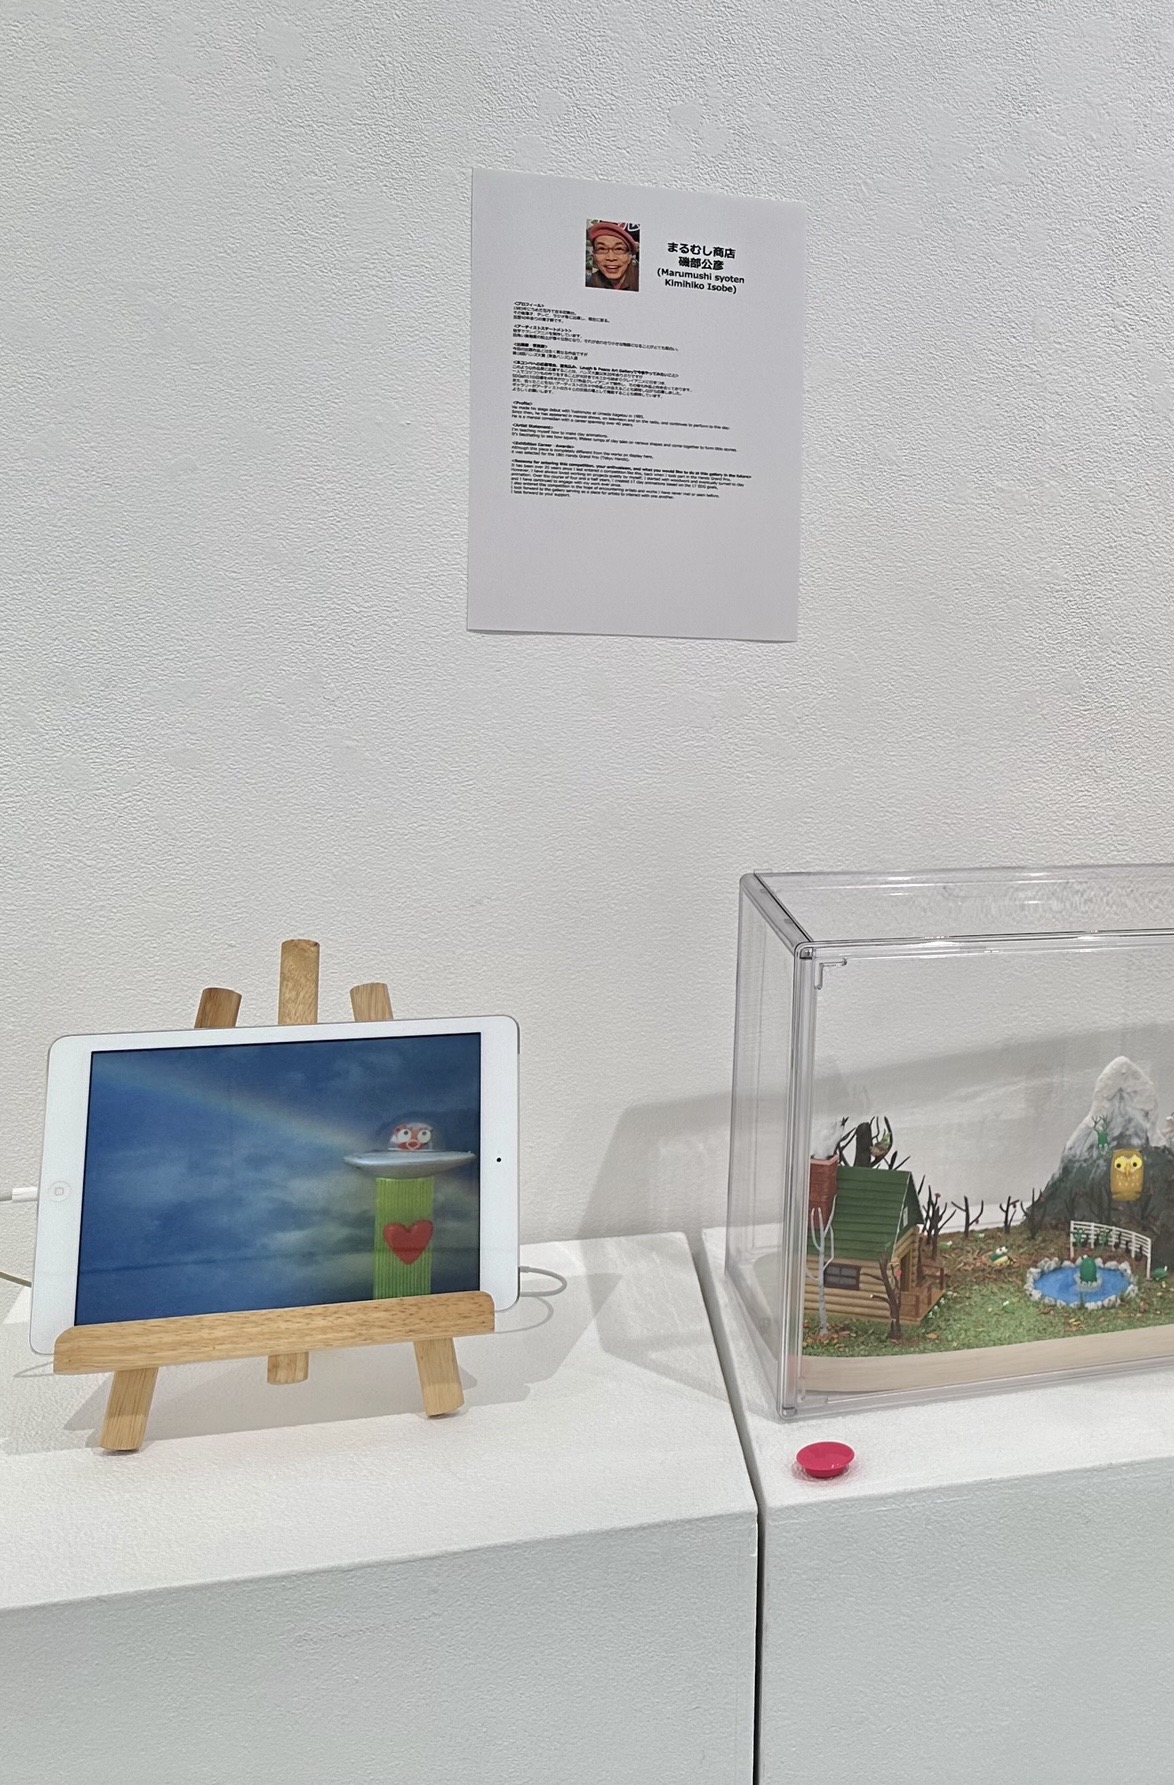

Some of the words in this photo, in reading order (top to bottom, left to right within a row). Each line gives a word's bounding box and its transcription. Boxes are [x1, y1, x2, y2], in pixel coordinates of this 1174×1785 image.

[667, 242, 736, 259] まるむし商店
[678, 256, 724, 271] 磯部公彦
[657, 267, 712, 281] (Marumushi
[714, 275, 745, 284] syoten
[664, 279, 705, 290] Kimihiko
[707, 283, 737, 294] Isobe)
